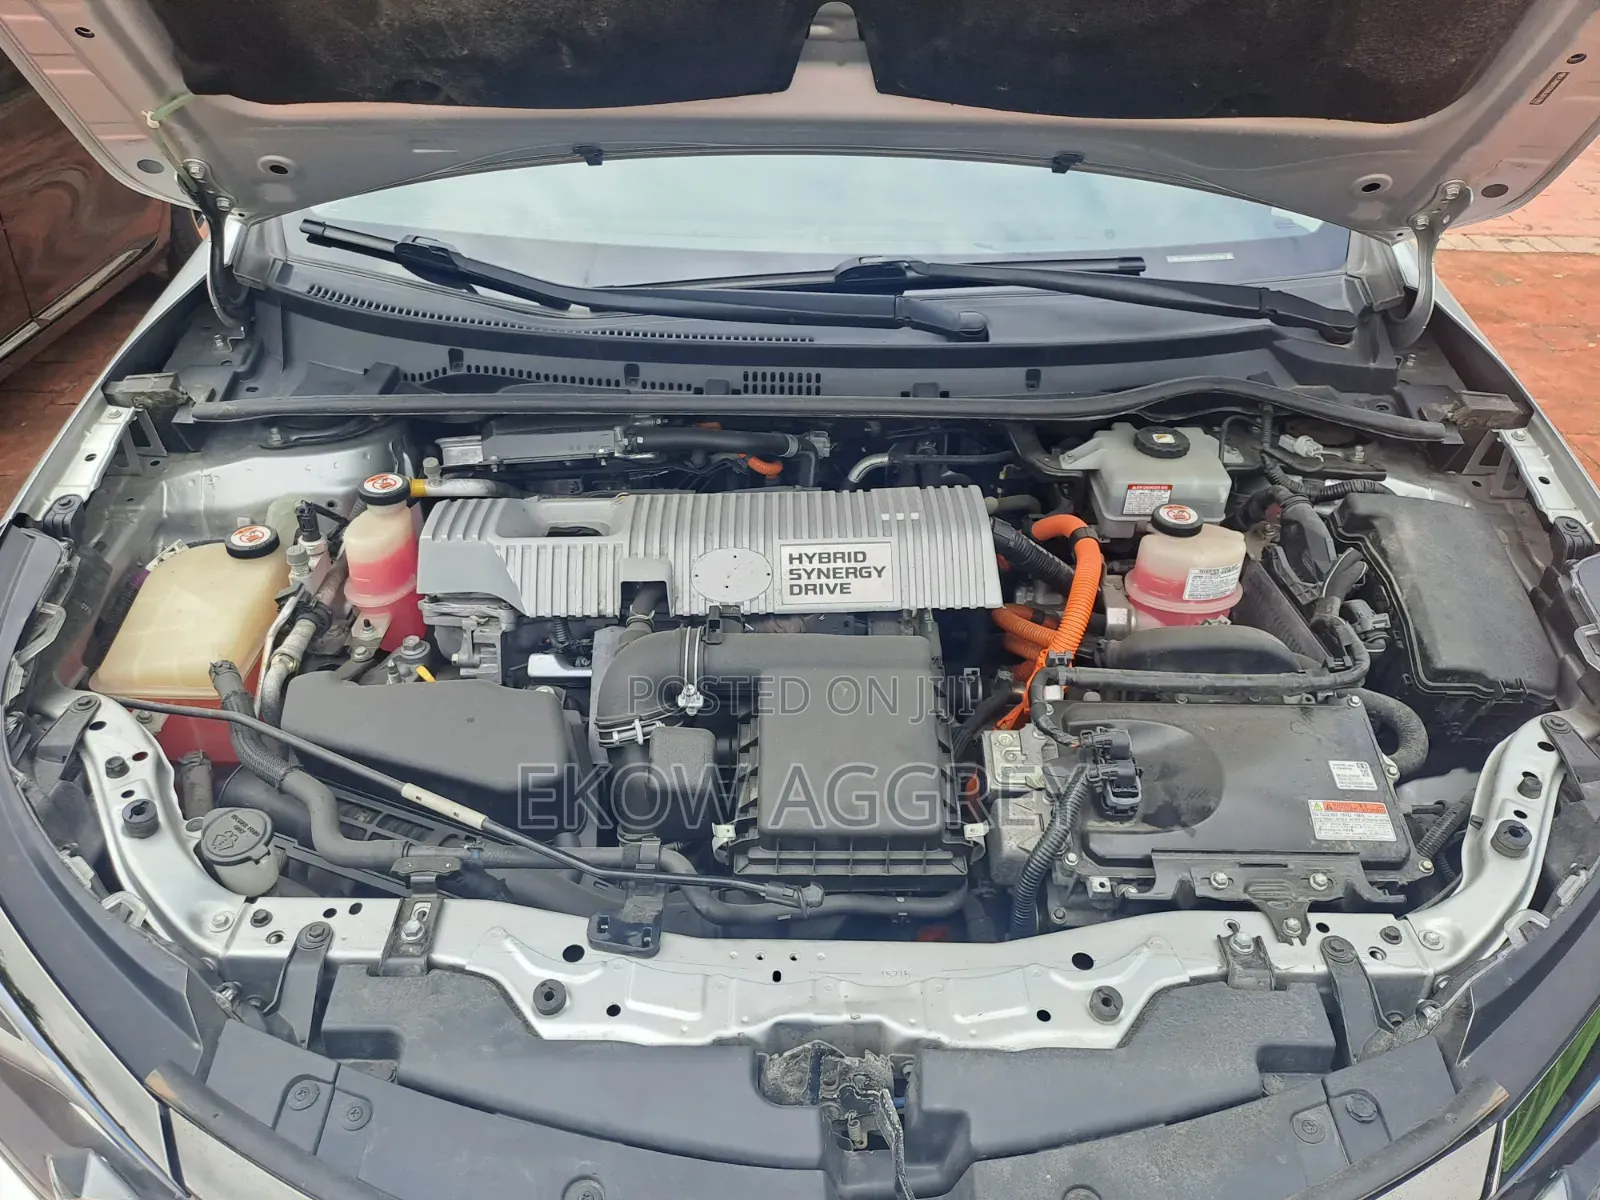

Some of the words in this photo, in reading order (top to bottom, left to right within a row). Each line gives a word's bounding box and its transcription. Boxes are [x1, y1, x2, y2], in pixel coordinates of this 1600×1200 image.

[788, 550, 867, 565] HYBRID
[788, 565, 887, 581] SYNERGY
[789, 582, 852, 596] DRIVE
